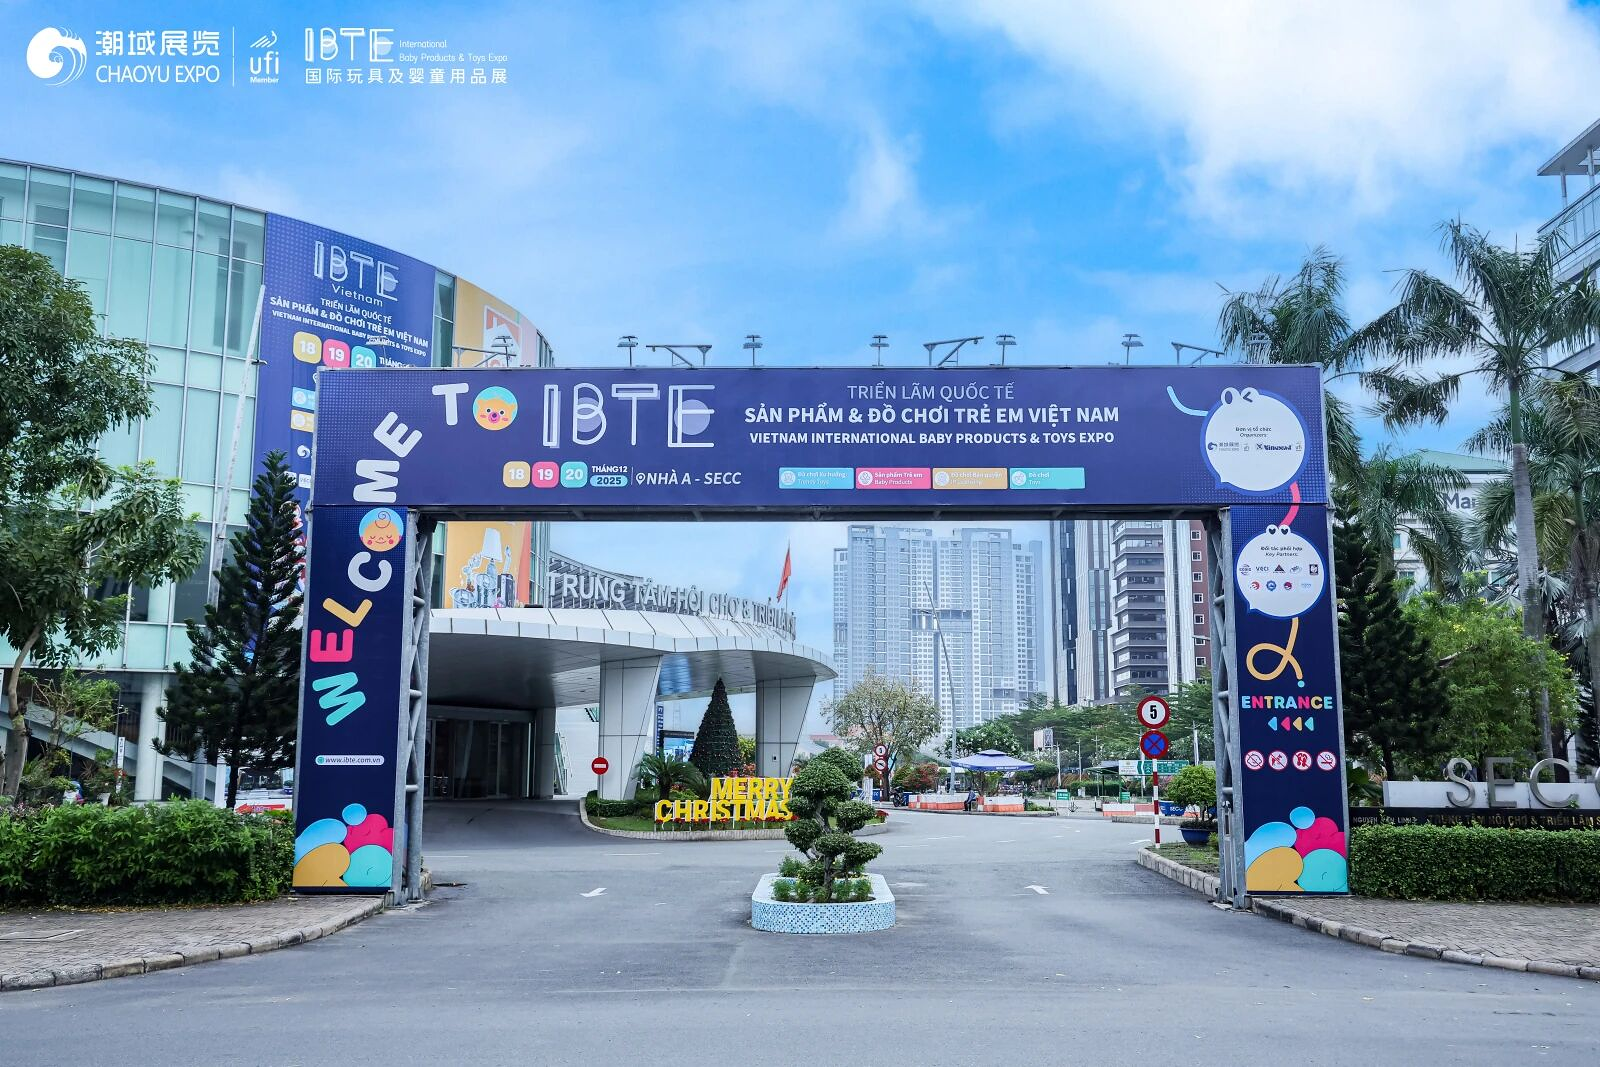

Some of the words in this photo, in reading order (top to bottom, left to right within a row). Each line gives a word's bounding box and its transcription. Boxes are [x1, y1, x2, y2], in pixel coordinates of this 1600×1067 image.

[314, 240, 399, 301] IBTE
[331, 283, 383, 307] Vietnam
[272, 310, 302, 322] VIETNAM
[302, 318, 350, 334] INTERNATIONAL
[352, 330, 366, 338] BABY
[400, 344, 414, 352] TOYS
[414, 348, 426, 356] EXPO
[320, 310, 328, 318] &
[384, 326, 394, 337] EM
[414, 336, 428, 348] NAM
[300, 340, 316, 354] 18
[328, 348, 344, 362] 19
[356, 354, 372, 368] 20
[848, 381, 896, 400] TRIỂN
[902, 382, 934, 400] LÃM
[940, 382, 990, 402] QUỐC
[994, 382, 1014, 400] TẾ
[542, 382, 715, 448] IBTE
[744, 403, 782, 423] SẢN
[788, 402, 843, 423] PHẨM
[848, 408, 862, 424] &
[868, 402, 896, 424] ĐỒ
[901, 404, 948, 424] CHƠI
[954, 404, 990, 424] TRẺ
[996, 408, 1024, 424] EM
[1028, 404, 1072, 428] VIỆT
[1076, 407, 1119, 422] NAM
[750, 432, 808, 444] VIETNAM
[812, 432, 916, 444] INTERNATIONAL
[920, 433, 952, 444] BABY
[956, 433, 1026, 444] PRODUCTS
[1030, 433, 1040, 444] &
[1042, 432, 1076, 444] TOYS
[1079, 432, 1114, 443] EXPO
[509, 468, 524, 480] 18
[538, 468, 554, 480] 19
[566, 468, 584, 480] 20
[592, 464, 628, 473] THÁNG12
[596, 476, 622, 484] 2025
[647, 470, 678, 485] NHÀ
[682, 474, 692, 484] A
[704, 472, 742, 485] SECC
[546, 572, 626, 602] TRUNG
[632, 577, 673, 607] TÂM
[676, 585, 704, 617] HỘI
[710, 593, 739, 620] CHỢ
[742, 599, 750, 618] &
[1242, 696, 1332, 710] ENTRANCE
[1150, 704, 1158, 720] 5
[326, 756, 381, 764] www.ibte.com.vn
[712, 778, 793, 800] MERRY
[656, 800, 793, 822] CHRISTMAS
